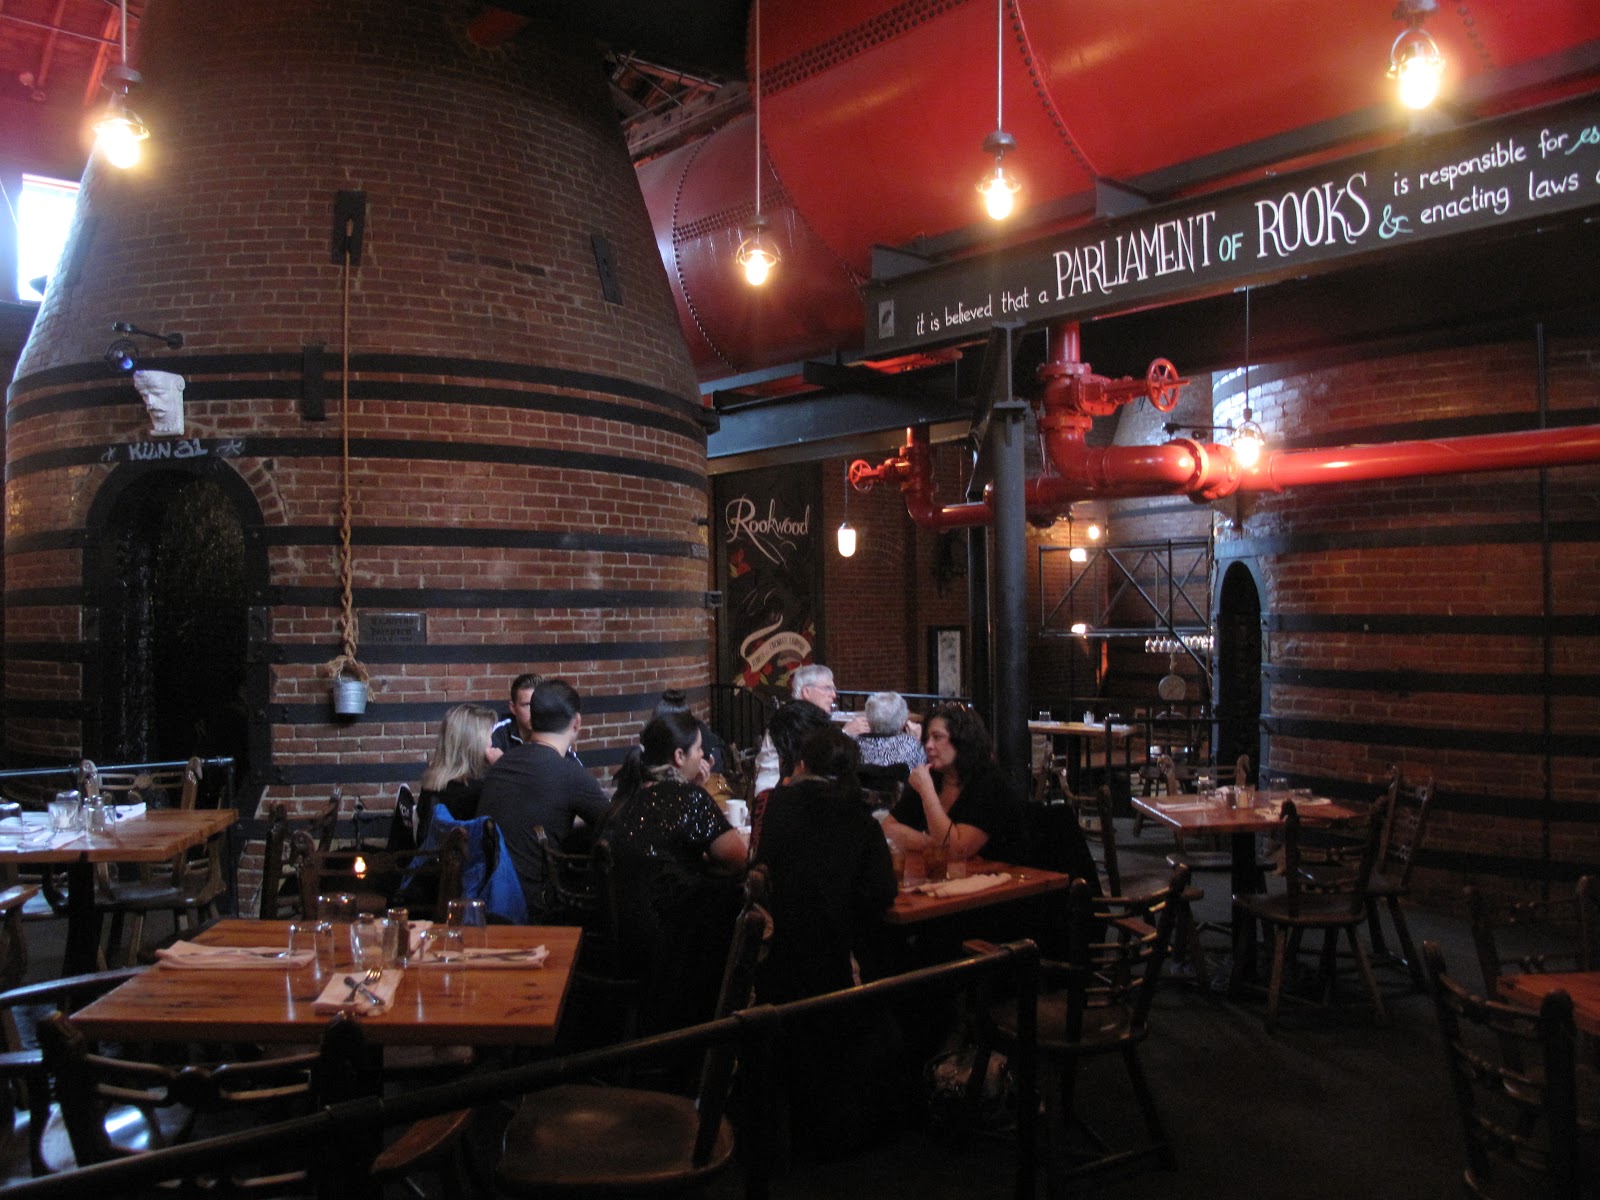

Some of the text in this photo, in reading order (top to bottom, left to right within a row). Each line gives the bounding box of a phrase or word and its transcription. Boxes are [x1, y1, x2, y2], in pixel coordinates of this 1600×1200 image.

[1394, 172, 1409, 196] is
[1419, 138, 1527, 190] responsible
[1538, 128, 1569, 159] for
[1378, 204, 1413, 240] &
[1420, 186, 1509, 224] enacting
[1528, 170, 1579, 201] laws
[916, 171, 1370, 336] it is believed that a PARLIAMENT OF ROOKS
[725, 494, 811, 565] Rookwood
